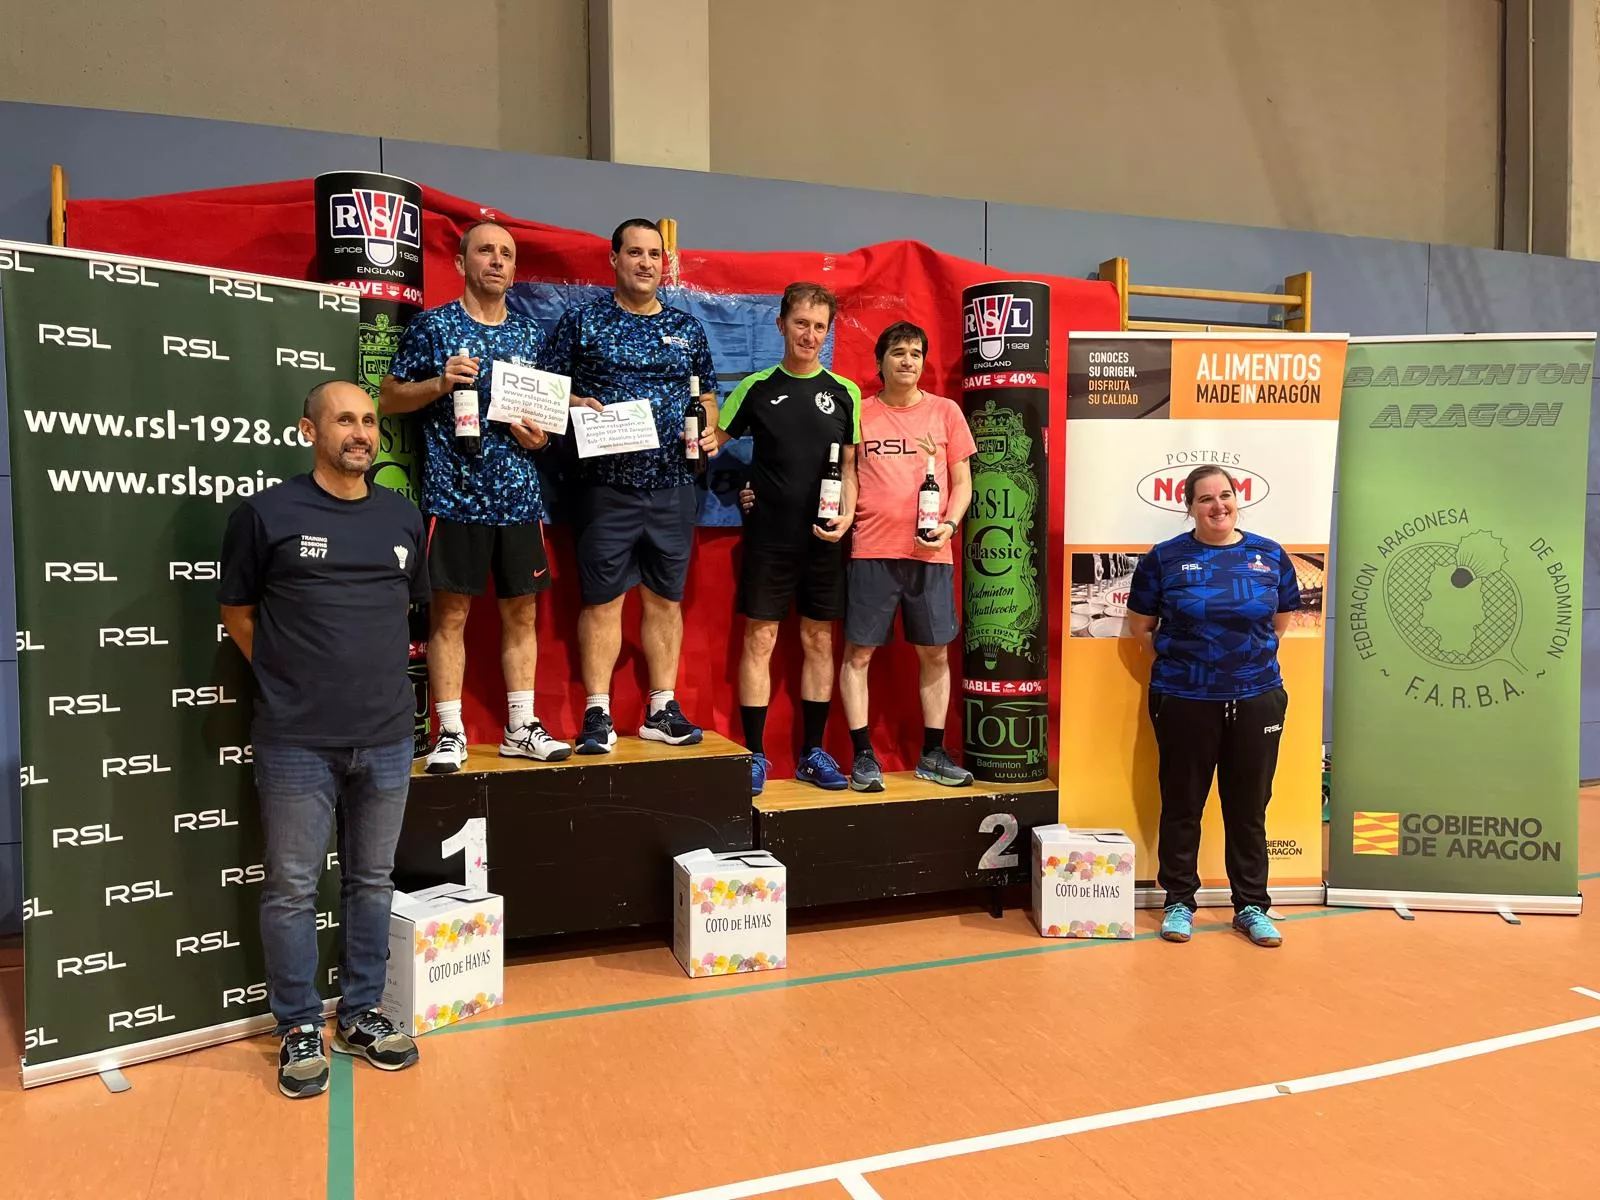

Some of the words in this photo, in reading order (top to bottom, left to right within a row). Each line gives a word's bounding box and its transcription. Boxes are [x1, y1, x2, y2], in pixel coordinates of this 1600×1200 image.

[335, 205, 418, 237] RSL
[400, 251, 418, 262] 1928
[88, 260, 160, 288] RSL
[357, 267, 404, 277] ENGLAND
[209, 276, 274, 303] RSL
[319, 291, 360, 313] RS
[964, 308, 1029, 333] RSL
[39, 324, 112, 350] RSL
[163, 335, 230, 361] RSL
[276, 348, 336, 372] RSL
[973, 360, 1012, 369] ENGLAND
[1089, 352, 1129, 363] CONOCES
[1196, 353, 1321, 381] ALIMENTOS
[502, 372, 548, 396] RSL
[964, 374, 992, 389] SAVE
[1009, 373, 1037, 384] 40%
[1088, 367, 1100, 377] SU
[1103, 367, 1137, 378] ORIGEN,
[1344, 363, 1591, 388] BADMINTON
[1088, 380, 1130, 391] DISFRUTA
[1088, 394, 1100, 405] SU
[1102, 394, 1138, 405] CALIDAD
[581, 410, 630, 425] RSL
[1369, 402, 1563, 428] ARAGON
[864, 438, 918, 458] RSL
[1166, 450, 1241, 465] POSTRES
[301, 535, 328, 543] TRAINING
[301, 540, 328, 548] SESSIONS
[300, 547, 327, 559] 24/7
[966, 543, 1022, 560] Classic
[45, 562, 118, 582] RSL
[1182, 563, 1202, 571] RSL
[968, 582, 1014, 602] Badminton
[1350, 563, 1379, 660] FEDERACION
[1377, 508, 1469, 558] ARAGONESA
[1529, 537, 1554, 560] DE
[1546, 562, 1572, 659] BADMINTON
[99, 626, 169, 647] RSL
[172, 685, 237, 708] RSL
[1018, 682, 1041, 692] 40%
[49, 693, 121, 716] RSL
[1263, 724, 1283, 734] RSL
[102, 754, 171, 778] RSL
[977, 759, 1021, 769] Badminton
[175, 808, 239, 833] RSL
[1402, 813, 1543, 838] GOBIERNO
[53, 823, 124, 849] RSL
[978, 813, 1018, 870] 2
[442, 817, 488, 895] 1
[1402, 836, 1437, 856] DE
[1446, 838, 1561, 862] ARAGON
[221, 864, 266, 887] RS
[105, 880, 174, 907] RSL
[1056, 883, 1078, 898] COTO
[1080, 888, 1091, 897] DE
[1093, 883, 1120, 898] HAYAS
[705, 917, 729, 933] COTO
[731, 919, 742, 930] DE
[744, 914, 772, 929] HAYAS
[177, 930, 240, 957] RSL
[57, 951, 127, 979] RSL
[429, 963, 451, 984] COTO
[453, 962, 463, 976] DE
[465, 949, 491, 972] HAYAS
[223, 982, 267, 1008] RS
[108, 1004, 176, 1033] RSL
